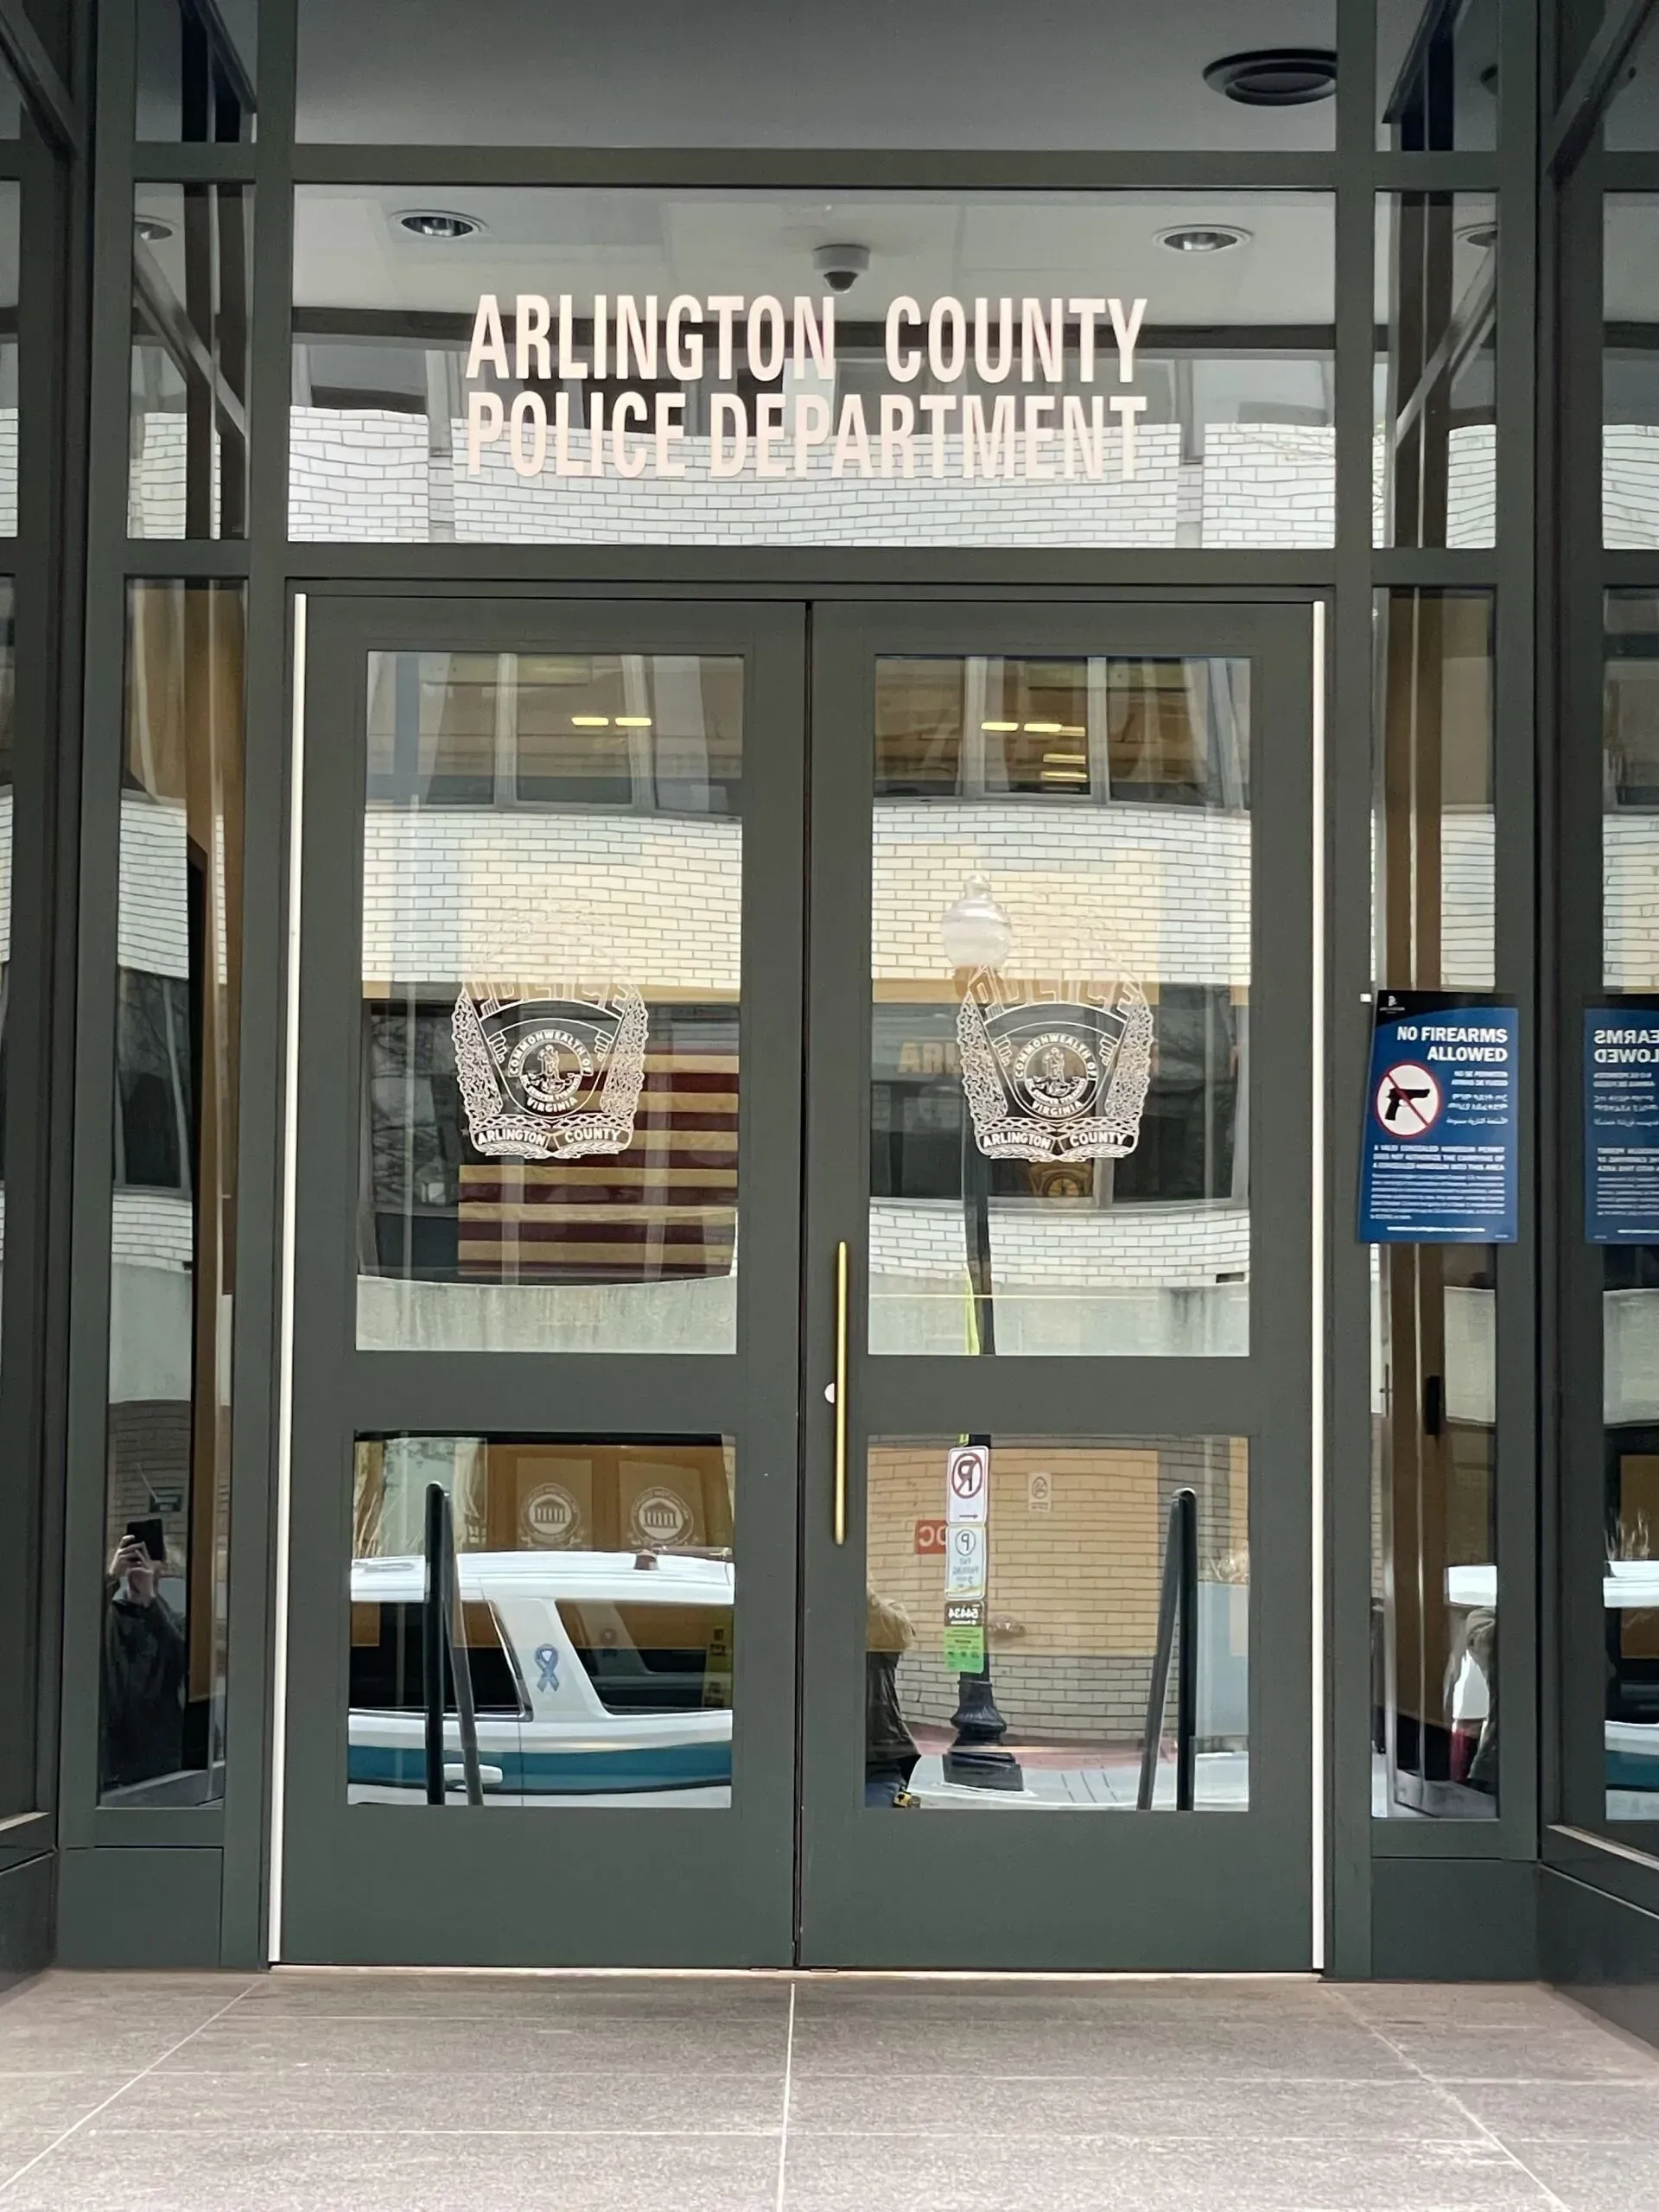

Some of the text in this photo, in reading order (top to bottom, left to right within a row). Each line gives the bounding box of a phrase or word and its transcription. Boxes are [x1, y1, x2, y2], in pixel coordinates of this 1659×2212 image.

[465, 295, 1147, 384] ARLINGTON COUNTY
[467, 391, 1148, 481] POLICE DEPARTMENT
[1396, 1026, 1508, 1044] NO FIREARMS
[510, 1029, 586, 1074] COMMONWEALTH
[1014, 1034, 1092, 1077] COMMONWEALTH
[1427, 1046, 1508, 1063] ALLOWED
[526, 1096, 578, 1113] VIRGINIA
[1032, 1100, 1084, 1116] VIRGINIA
[477, 1128, 620, 1147] ARLINGTON COUNTY
[982, 1131, 1126, 1149] ARLINGTON COUNTY
